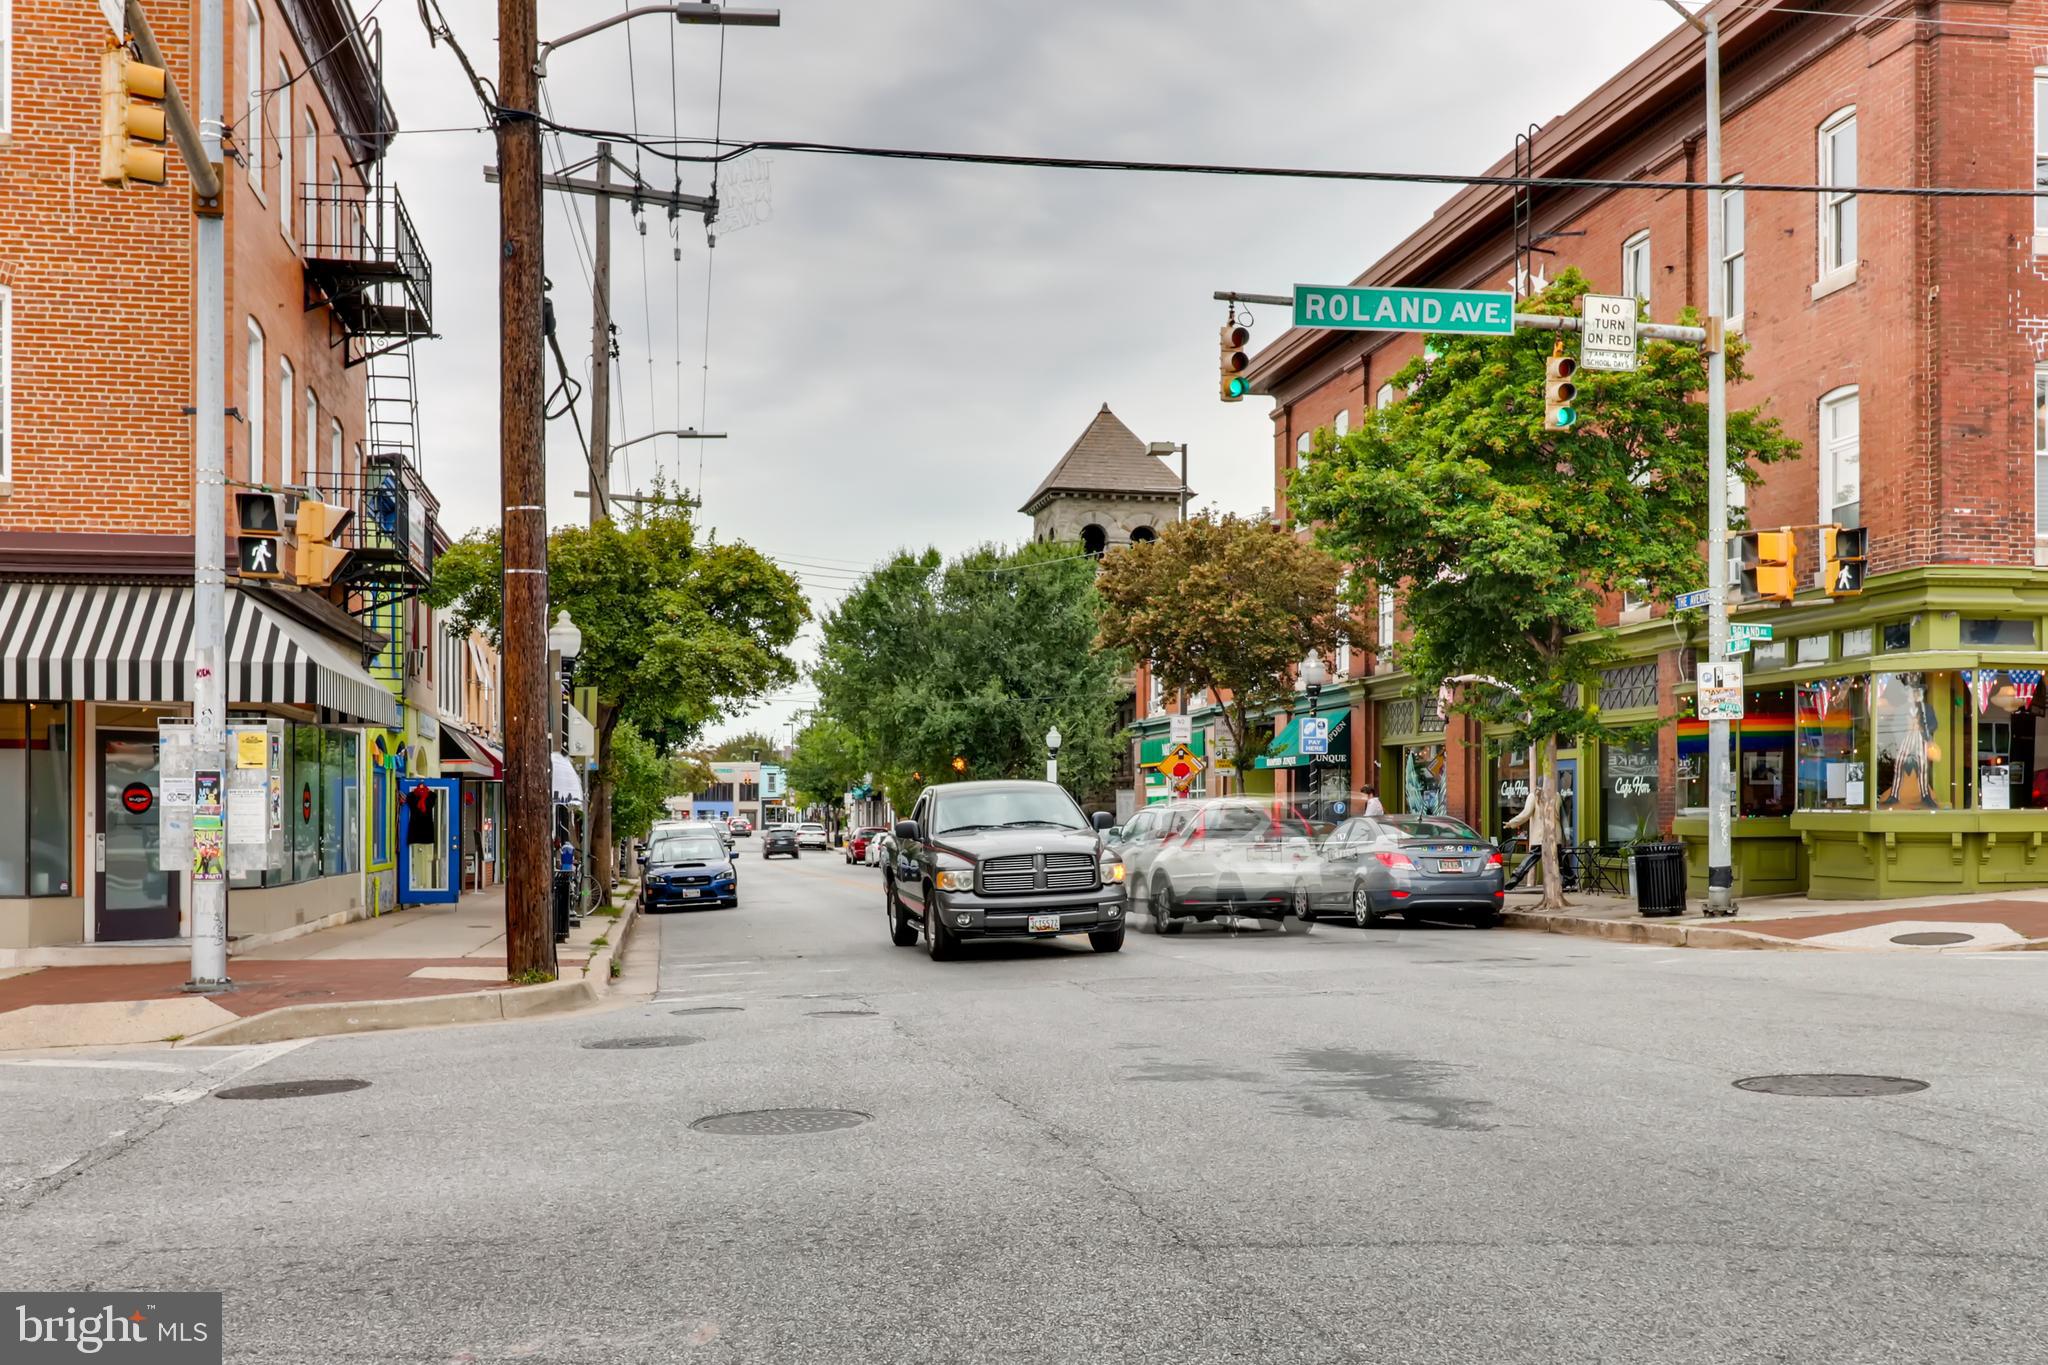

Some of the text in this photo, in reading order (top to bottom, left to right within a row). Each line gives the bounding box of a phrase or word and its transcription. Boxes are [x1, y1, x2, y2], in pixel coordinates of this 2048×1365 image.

[1305, 293, 1508, 324] ROLAND AVE.
[1601, 303, 1621, 315] NO
[1595, 318, 1625, 330] TURN
[1587, 332, 1632, 346] ON RED
[1586, 358, 1612, 367] SCHOOL
[1677, 596, 1688, 608] THE
[1732, 625, 1760, 638] ROLAND
[1328, 720, 1347, 742] PDEN
[1315, 754, 1347, 763] UNQUE
[1615, 777, 1632, 798] Cafe
